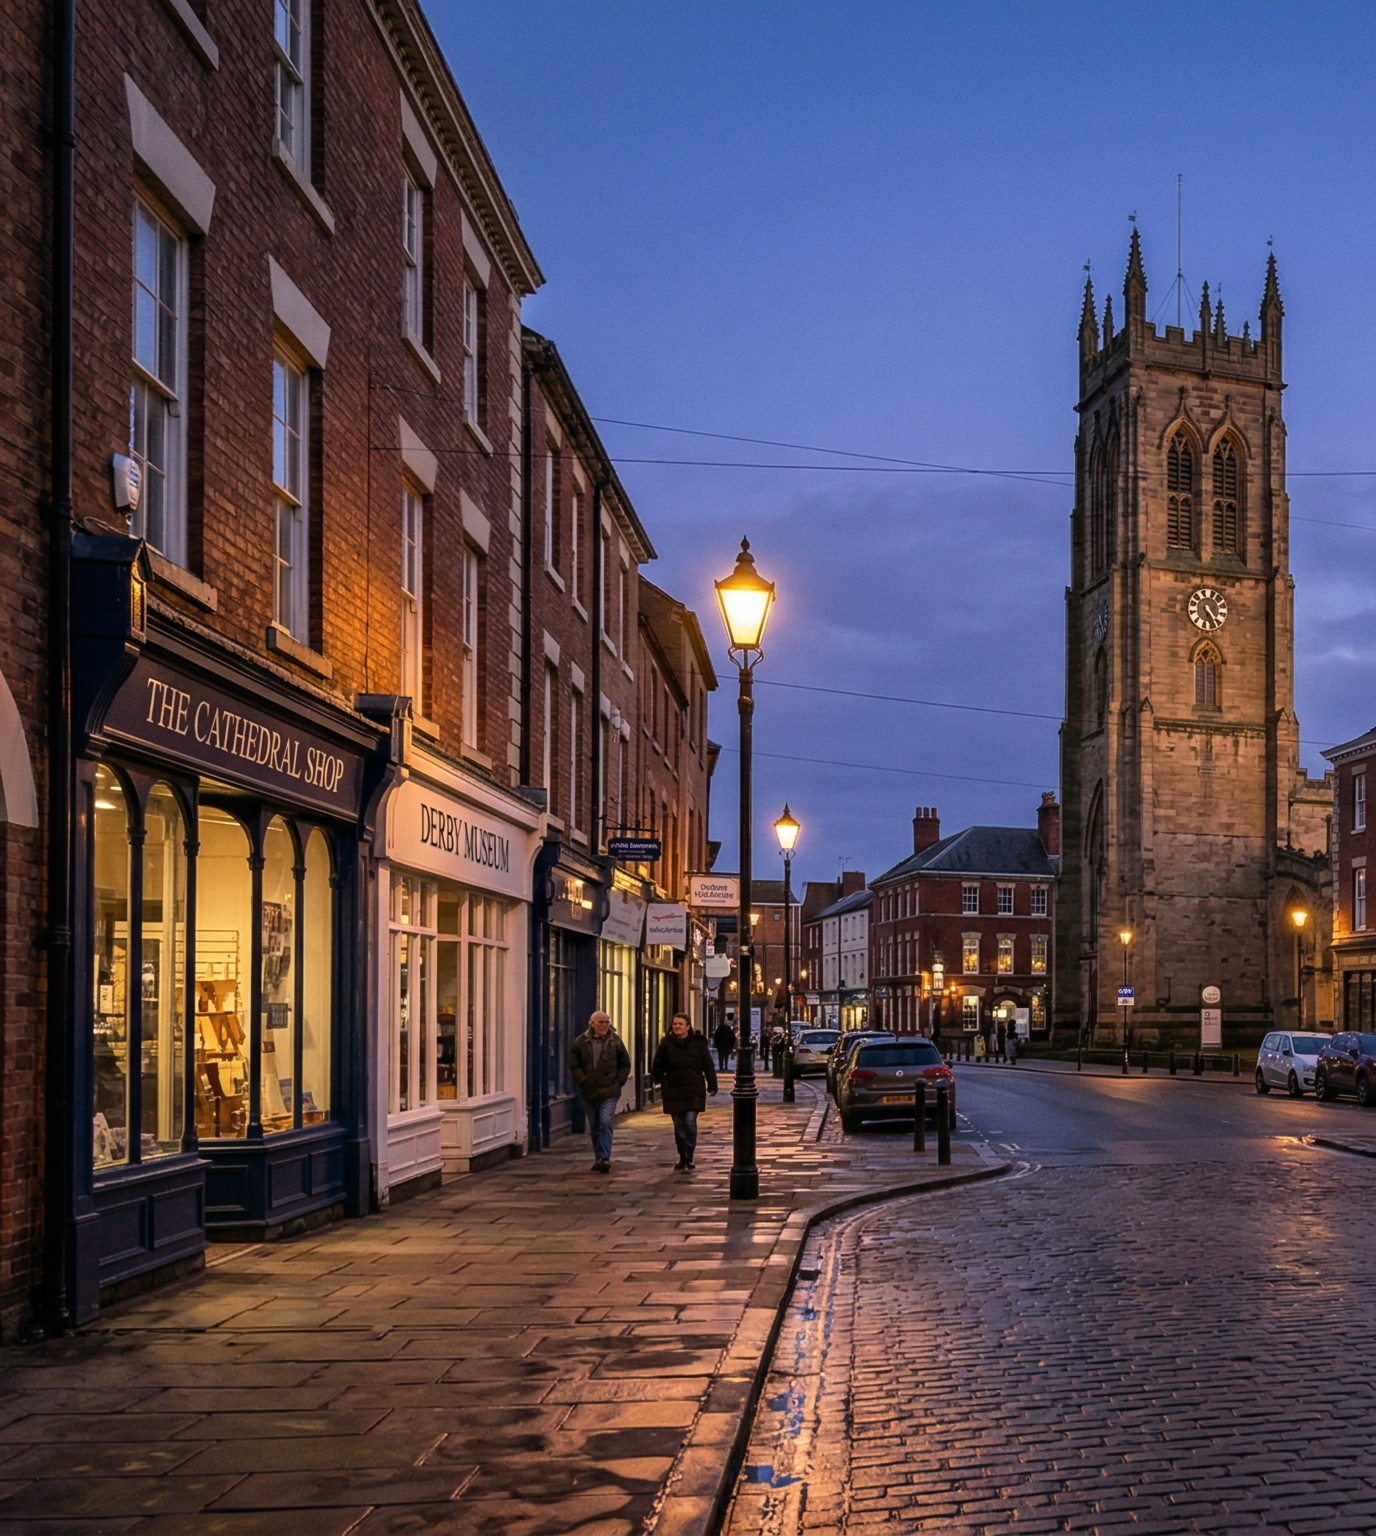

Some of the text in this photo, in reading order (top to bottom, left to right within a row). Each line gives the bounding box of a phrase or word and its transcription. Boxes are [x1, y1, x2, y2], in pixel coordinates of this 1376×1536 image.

[146, 678, 344, 793] THE CATHEDRAL SHOP
[420, 803, 509, 873] DERBY MUSEUM
